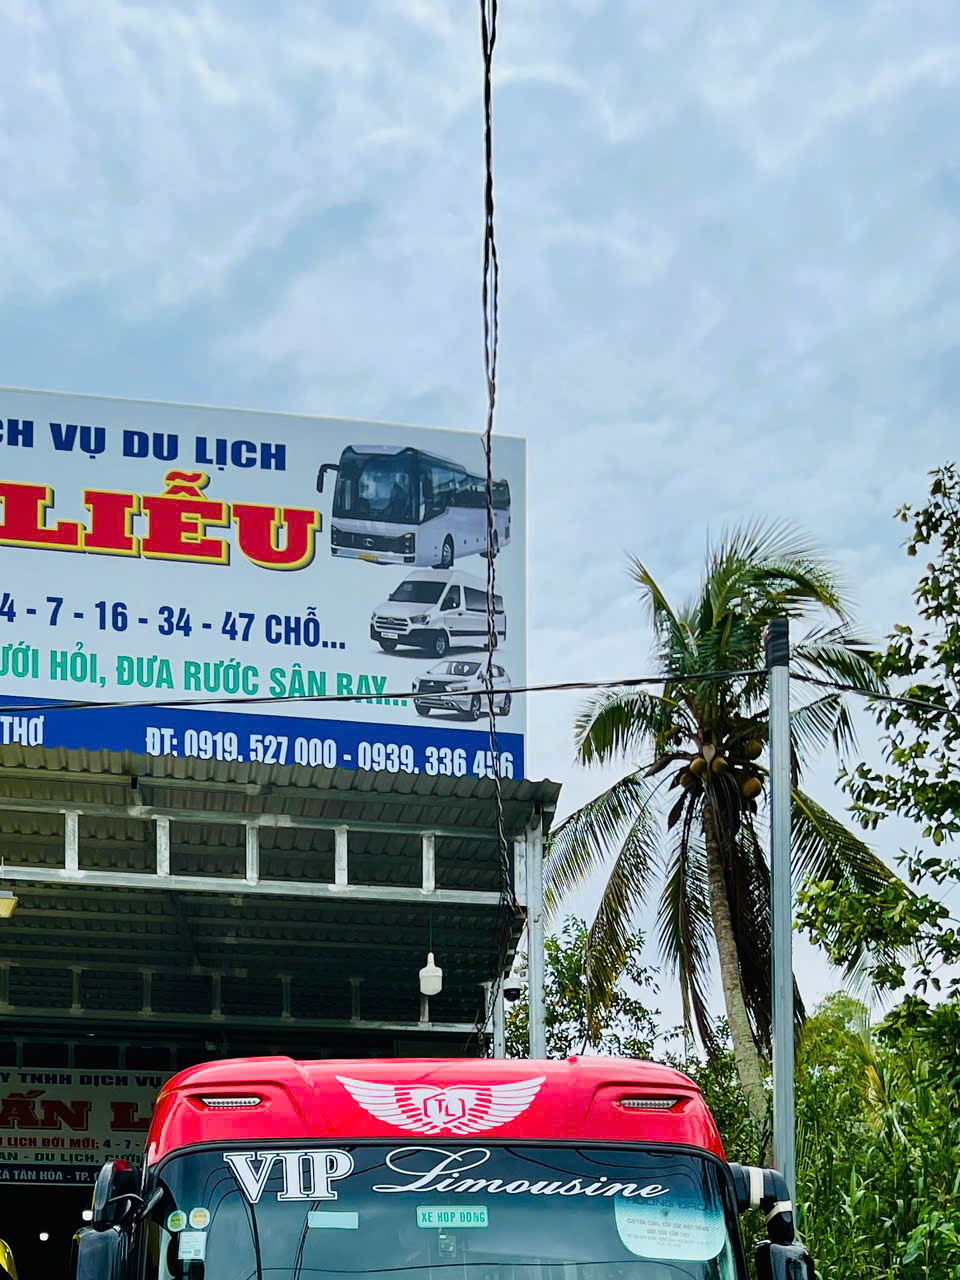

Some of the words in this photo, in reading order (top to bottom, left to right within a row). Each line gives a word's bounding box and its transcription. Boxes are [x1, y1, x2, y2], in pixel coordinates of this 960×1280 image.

[49, 422, 106, 459] VỤ
[122, 429, 178, 461] DU
[195, 436, 286, 471] LỊCH
[0, 592, 16, 623] 4
[46, 596, 64, 626] 7
[95, 601, 128, 632] 16
[158, 606, 192, 637] 34
[221, 611, 255, 641] 47
[265, 607, 346, 650] CHỖ...
[50, 641, 106, 688] HỎI,
[116, 655, 174, 689] ĐƯA
[184, 657, 259, 695] RƯỚC
[269, 662, 327, 698] SÂN
[0, 715, 44, 747] THƠ
[145, 727, 178, 757] ĐT:
[184, 730, 243, 762] 0919.
[249, 734, 288, 765] 527
[294, 737, 337, 768] 000
[357, 741, 420, 776] 0939.
[425, 745, 465, 778] 336
[472, 748, 514, 780] 456
[18, 1073, 72, 1085] TNHH
[80, 1074, 128, 1087] DỊCH
[135, 1075, 162, 1089] VỤ
[34, 1152, 55, 1162] DU
[102, 1139, 111, 1148] 4
[123, 1139, 131, 1149] 7
[223, 1149, 355, 1203] VIP
[372, 1146, 670, 1199] Limousine
[421, 1211, 433, 1223] XE
